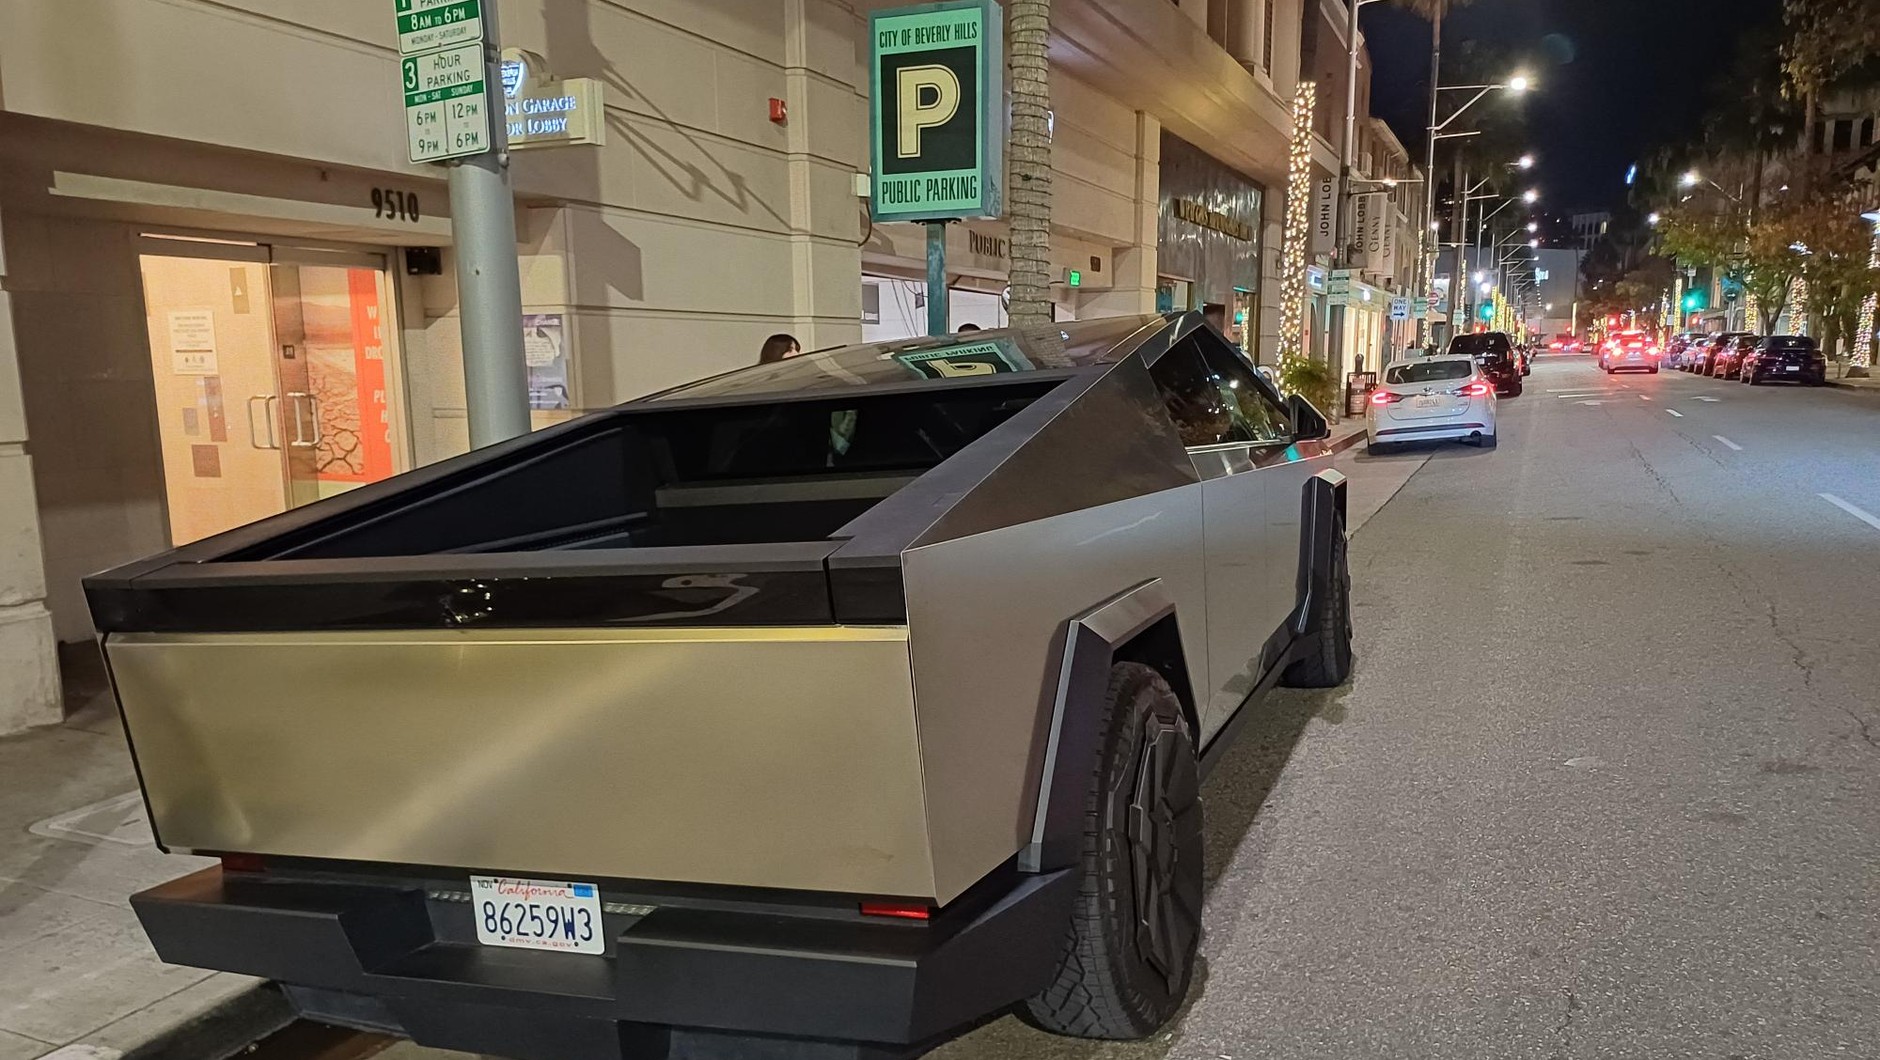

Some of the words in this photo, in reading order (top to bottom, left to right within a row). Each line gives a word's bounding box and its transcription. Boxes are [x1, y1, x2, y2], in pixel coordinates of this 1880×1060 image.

[879, 30, 898, 48] CITY
[901, 28, 912, 46] OF
[915, 24, 951, 45] BEVERLY
[954, 21, 978, 41] HILLS
[404, 61, 416, 89] 3
[433, 54, 461, 70] HOUR
[427, 69, 471, 88] PARKING
[451, 84, 473, 97] SUNDAY
[414, 94, 427, 103] MON
[431, 90, 441, 100] SAT
[522, 96, 577, 115] GARAGE
[896, 64, 961, 159] P
[527, 117, 568, 135] LOBBY
[882, 179, 921, 205] PUBLIC
[926, 175, 977, 202] PARKING
[371, 187, 419, 223] 9510
[1357, 195, 1366, 223] LOBB
[1320, 204, 1330, 237] JOHN
[968, 229, 1005, 259] PUBLIC
[1355, 227, 1363, 254] JOHN
[497, 878, 574, 901] California
[483, 901, 593, 941] 86259W3
